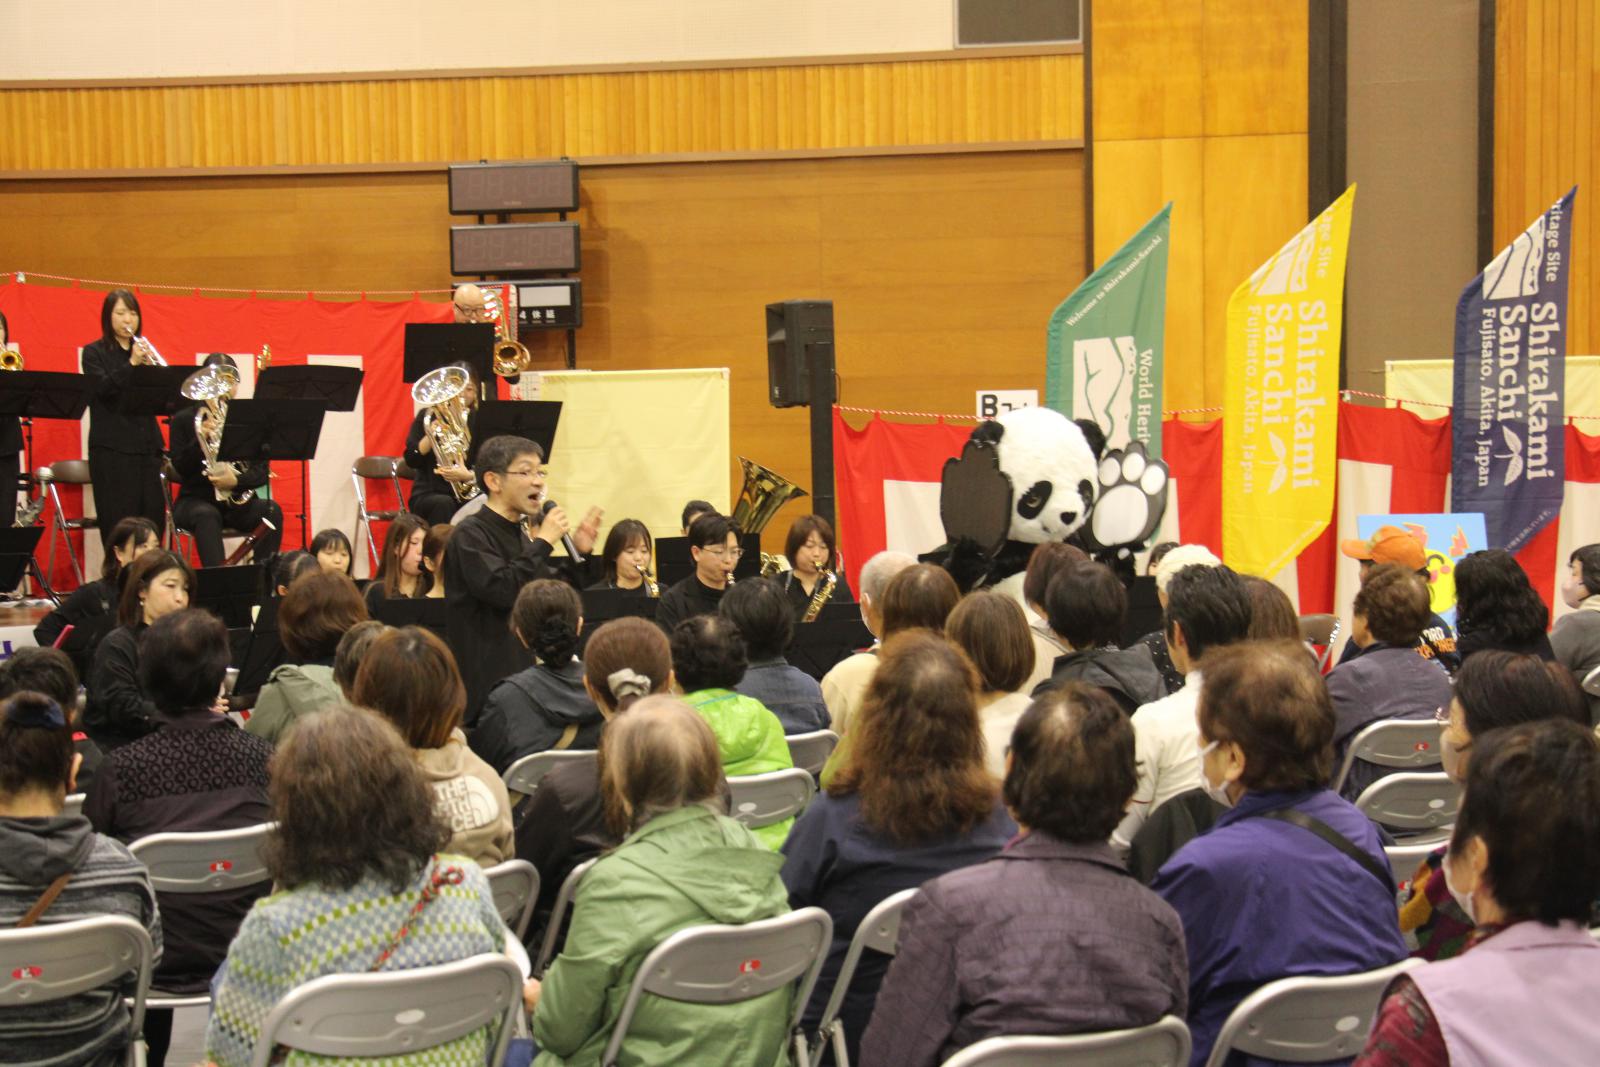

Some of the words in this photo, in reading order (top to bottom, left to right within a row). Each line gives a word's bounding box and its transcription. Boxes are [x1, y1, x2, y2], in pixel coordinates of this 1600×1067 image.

[1545, 252, 1561, 282] Site
[1065, 298, 1097, 327] Welcome
[1263, 303, 1293, 424] Sanchi
[1478, 307, 1496, 381] Fujisato,
[1497, 304, 1527, 421] Sanchi
[1138, 348, 1154, 399] World
[1292, 299, 1328, 489] Shirakami
[1526, 302, 1560, 480] Shirakami
[1478, 385, 1496, 435] Akita,
[1240, 445, 1257, 494] Japan
[1474, 439, 1493, 487] Japan
[432, 776, 467, 801] THE
